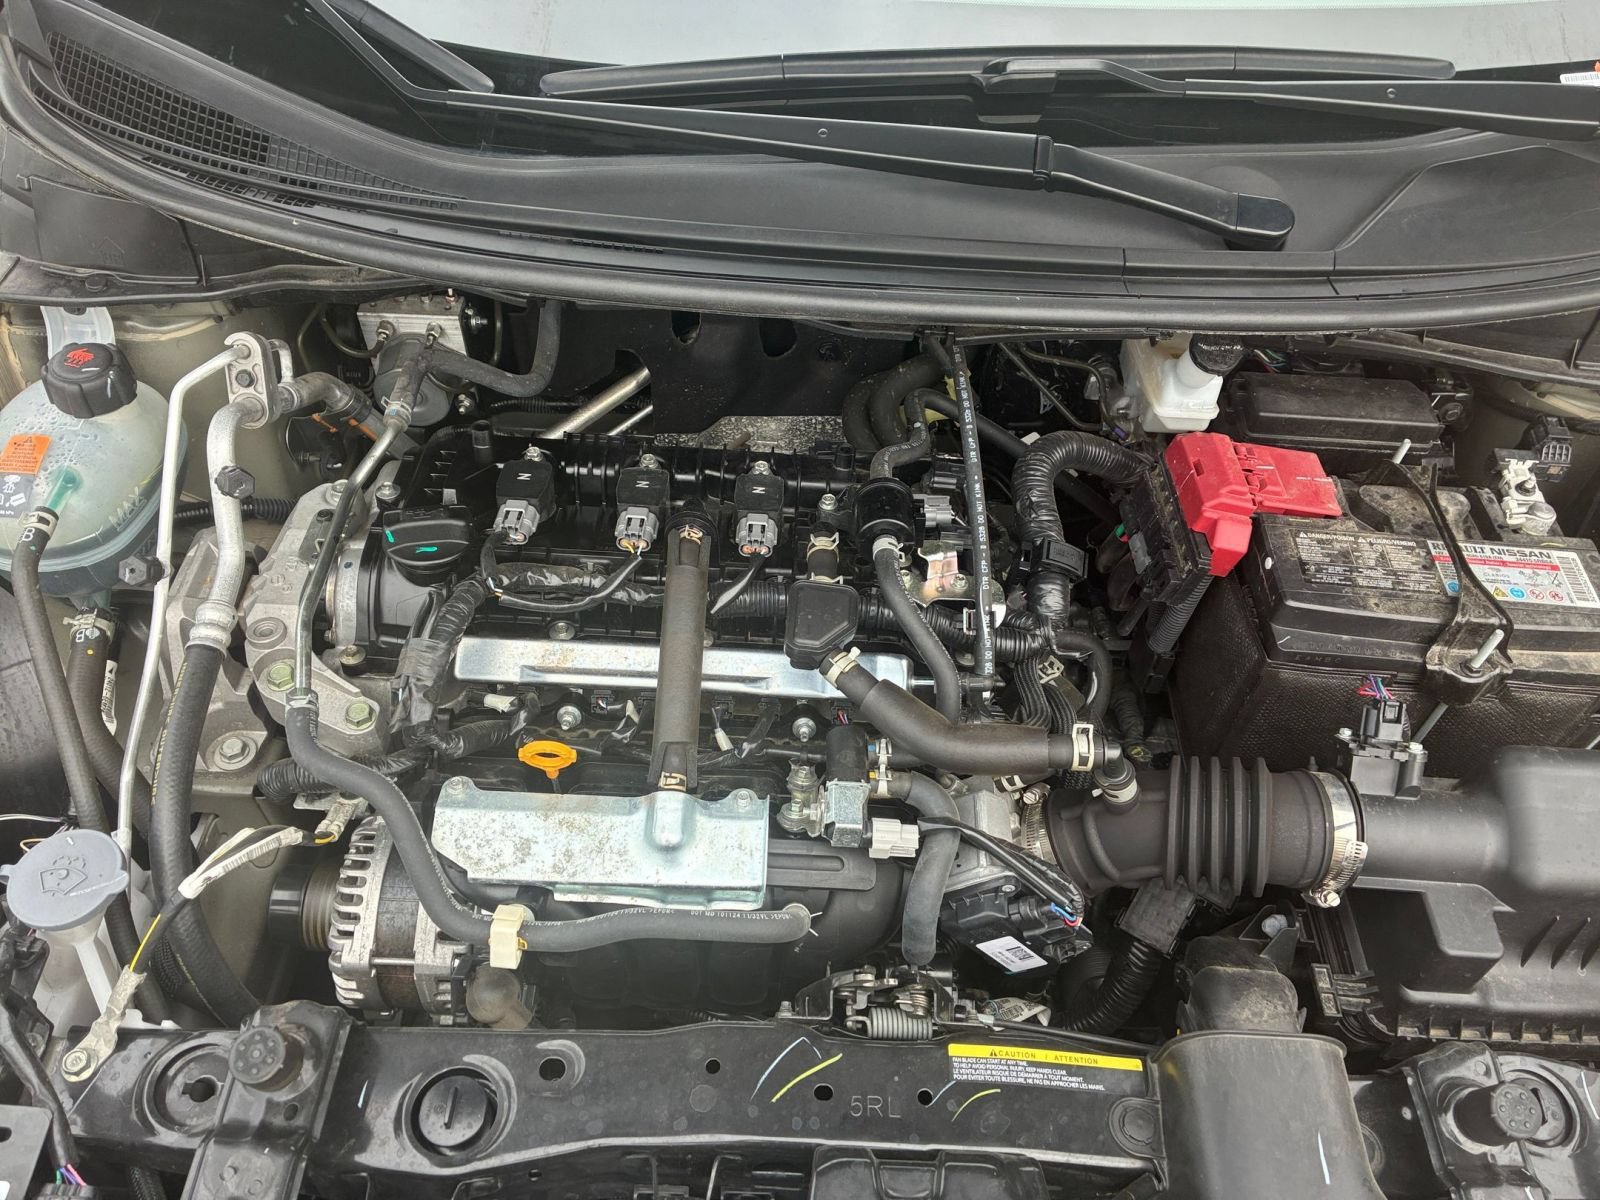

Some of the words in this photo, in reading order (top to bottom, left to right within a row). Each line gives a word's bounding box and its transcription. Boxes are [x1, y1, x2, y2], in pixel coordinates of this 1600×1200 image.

[977, 514, 984, 523] DO
[21, 527, 36, 543] B
[1489, 547, 1552, 560] NISSAN
[980, 559, 988, 572] CFP
[981, 576, 989, 589] DTR
[984, 650, 992, 659] DO
[998, 1050, 1036, 1059] CAUTION
[1054, 1055, 1098, 1064] ATTENTION
[850, 1095, 902, 1118] 5RL
